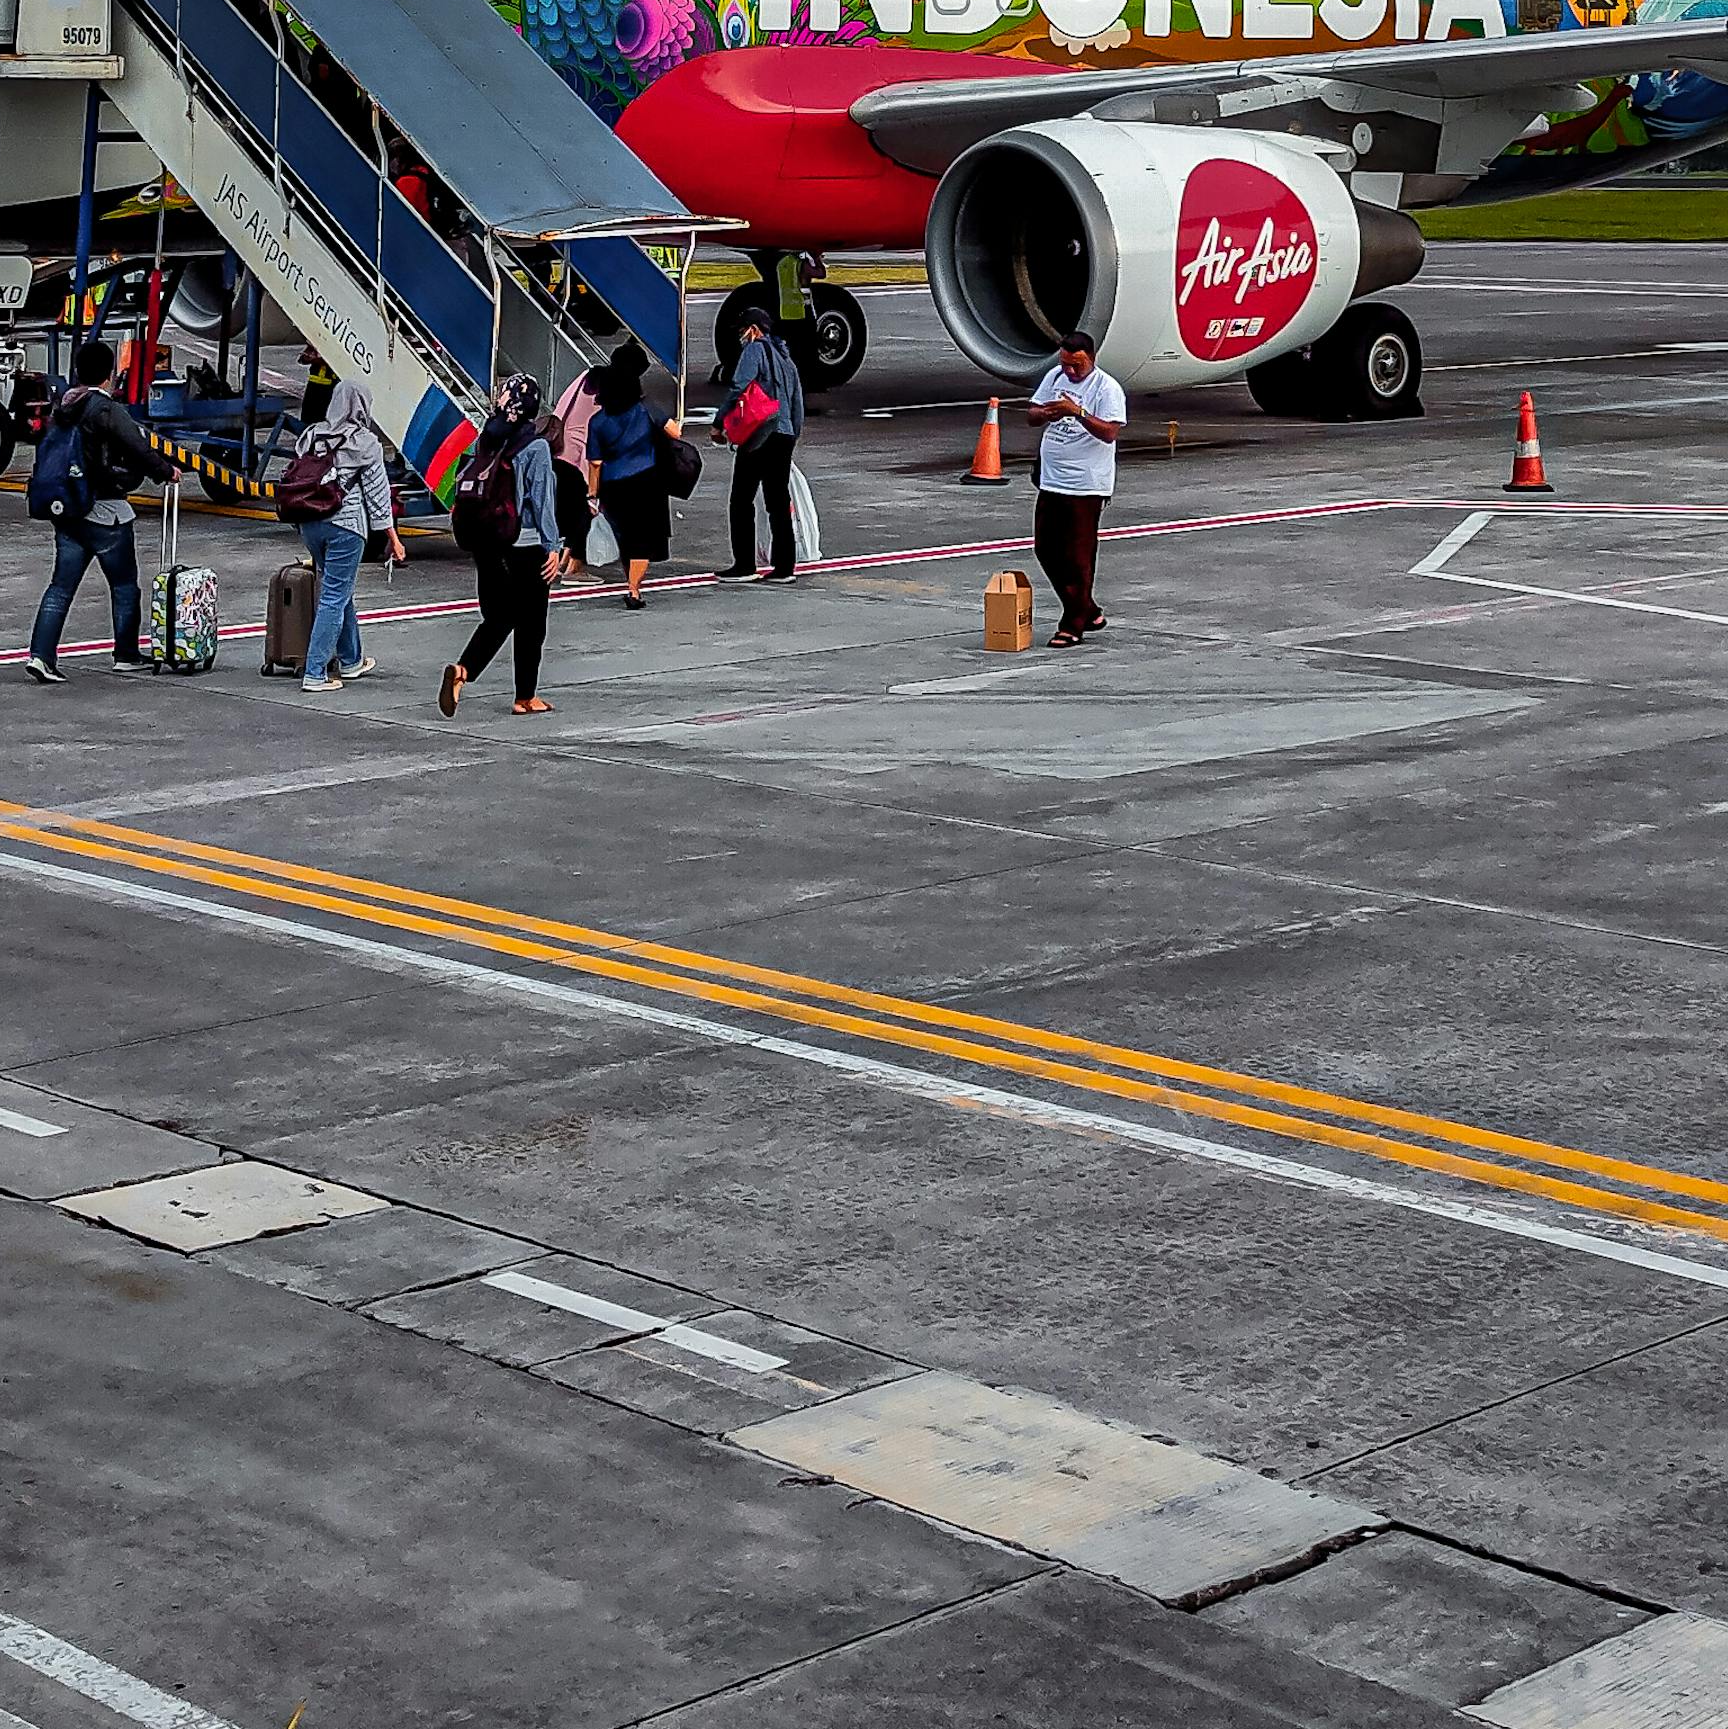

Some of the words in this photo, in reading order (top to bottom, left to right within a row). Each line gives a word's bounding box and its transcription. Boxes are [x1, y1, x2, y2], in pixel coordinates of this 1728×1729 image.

[62, 27, 102, 45] 95079
[212, 174, 249, 220] JAS
[244, 210, 304, 292] Airport
[302, 277, 374, 375] Services
